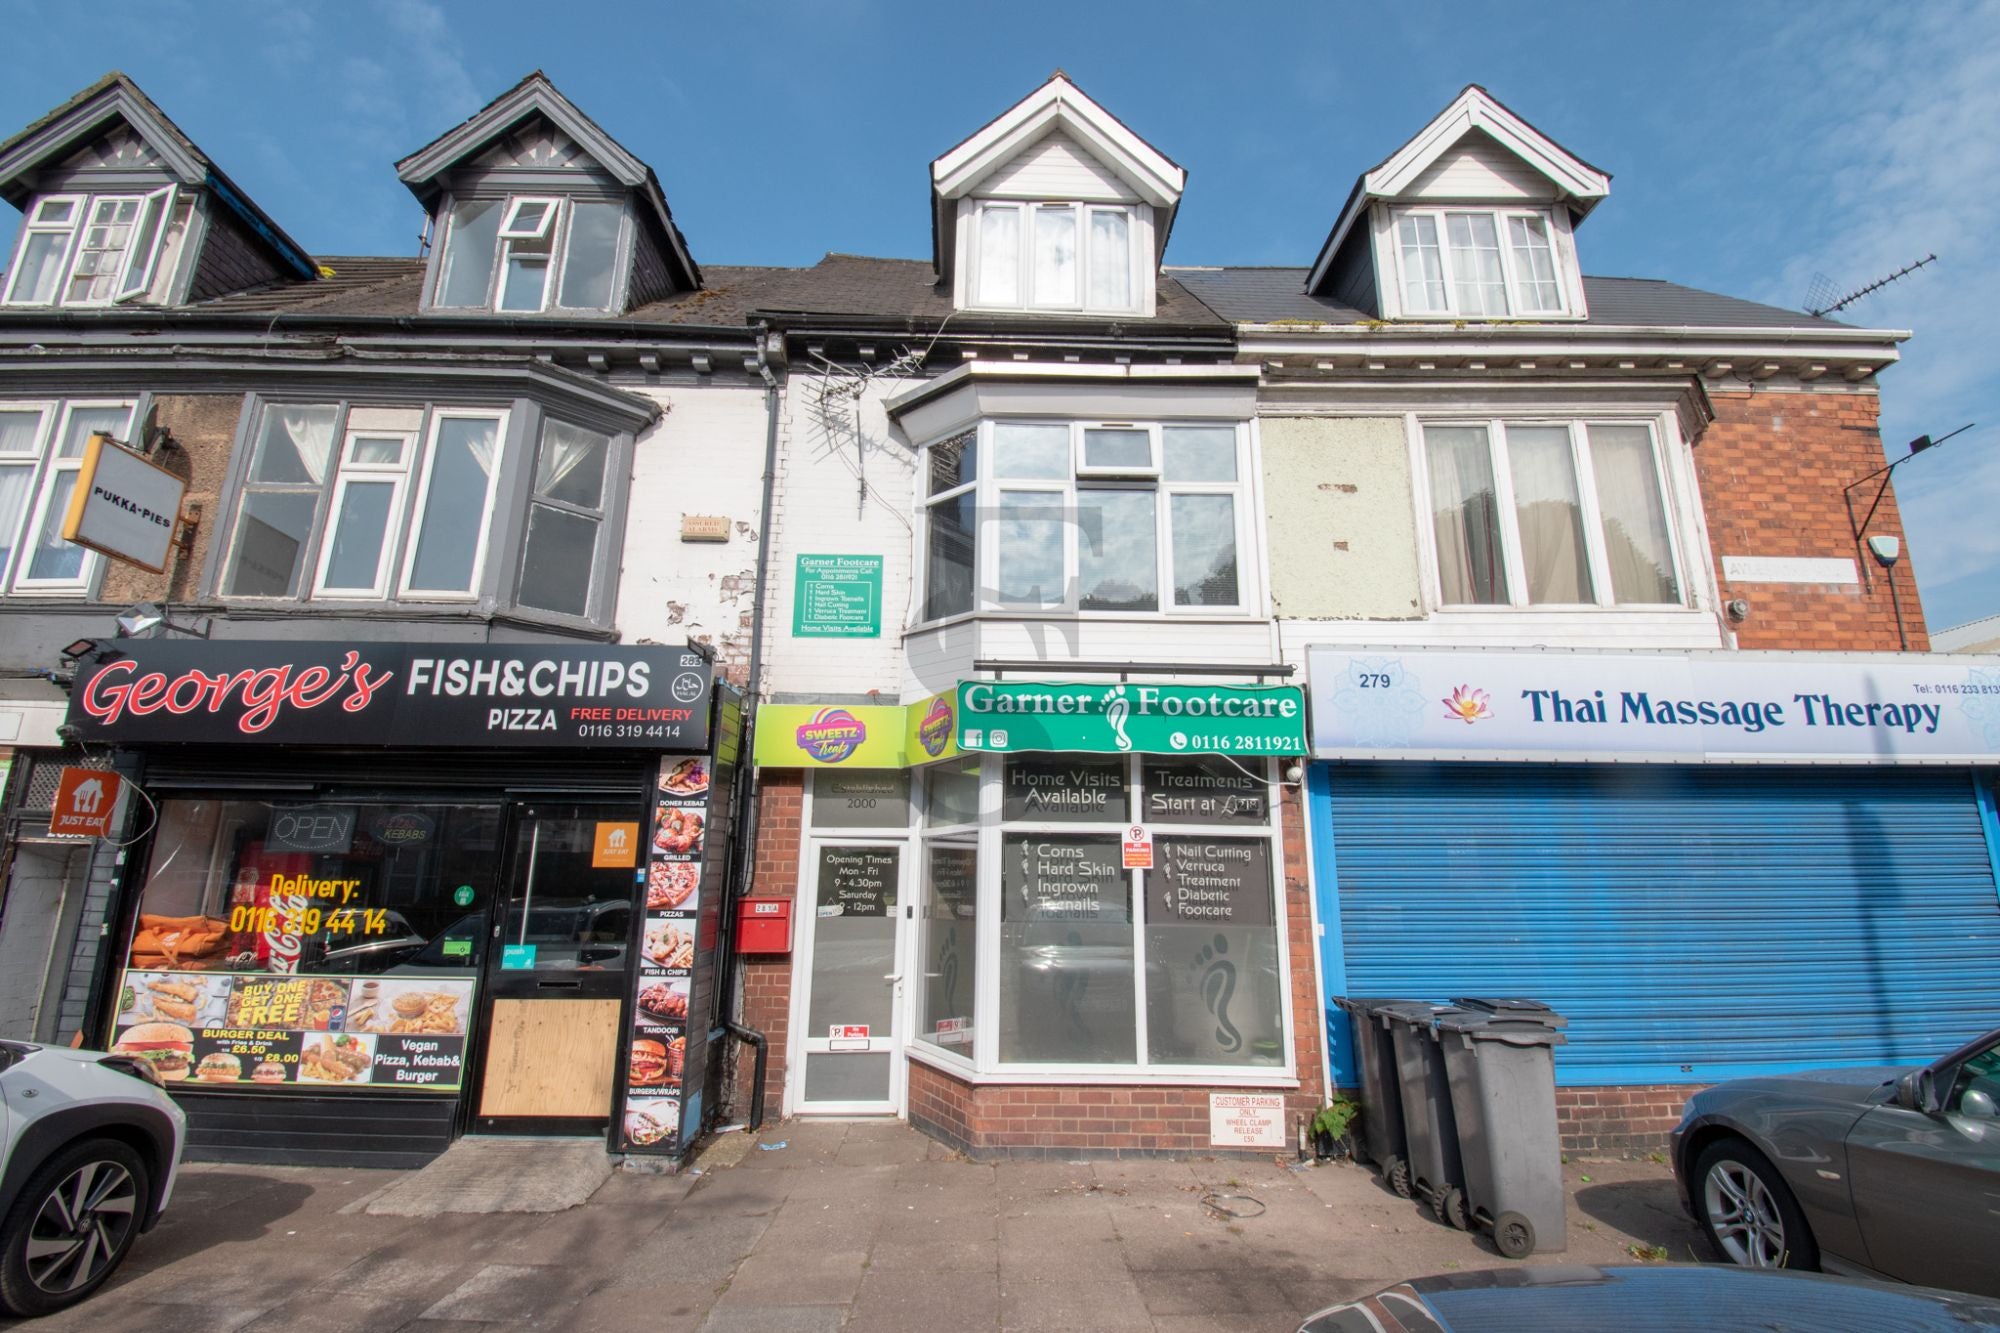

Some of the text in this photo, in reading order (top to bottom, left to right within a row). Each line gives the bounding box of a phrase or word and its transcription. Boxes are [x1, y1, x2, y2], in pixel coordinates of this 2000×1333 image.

[94, 487, 170, 528] PUKKA-PIES
[801, 557, 879, 566] Garner Footcare
[682, 656, 701, 665] 283
[407, 659, 650, 697] FISH&CHIPS
[1359, 674, 1391, 688] 279
[83, 650, 394, 734] George's
[1913, 684, 2000, 694] Tel: 0116 233 813
[965, 685, 1297, 718] Garner Footcare
[570, 707, 693, 721] FREE DELIVERY
[1521, 690, 1941, 733] Thai Massage Therapy
[487, 708, 558, 731] PIZZA
[579, 724, 680, 738] 0116 319 4414
[805, 727, 858, 741] SWEETZ
[1192, 735, 1301, 750] 0116 2811921
[1012, 770, 1121, 787] Home Visits
[1155, 771, 1253, 788] Treatments
[1025, 788, 1107, 804] Available
[1151, 793, 1195, 810] Start
[1200, 797, 1216, 811] at
[847, 799, 877, 809] 2000
[60, 814, 106, 826] JUST EAT
[384, 829, 427, 840] KEBABS
[1037, 844, 1085, 858] Corns
[1177, 845, 1252, 861] Nail Cutting
[826, 854, 893, 865] Opening Times
[1176, 859, 1225, 871] Verruca
[839, 867, 859, 875] Mon
[867, 867, 879, 875] Fri
[1038, 861, 1115, 875] Hard Skin
[1177, 873, 1241, 886] Treatment
[269, 873, 361, 904] Delivery:
[1038, 878, 1098, 896] Ingrown
[1178, 888, 1230, 900] Diabetic
[839, 890, 877, 901] Saturday
[853, 902, 875, 912] 12pm
[1037, 896, 1100, 911] Toenails
[1178, 902, 1232, 915] Footcare
[231, 905, 388, 935] 0116 319 44 14
[659, 910, 684, 918] PIZZAS
[504, 947, 525, 957] push
[644, 968, 660, 976] FISH
[667, 968, 688, 976] CHIPS
[243, 980, 306, 996] BUY ONE
[241, 992, 303, 1008] GET ONE
[236, 1002, 300, 1027] FREE
[202, 1029, 290, 1041] BURGER DEAL
[231, 1045, 266, 1054] £6.50
[401, 1039, 438, 1053] Vegan
[265, 1053, 299, 1063] £8.00
[374, 1055, 461, 1067] Pizza, Kebab&
[396, 1070, 438, 1083] Burger
[1215, 1096, 1280, 1107] CUSTOMER PARKING
[1239, 1108, 1257, 1116] ONLY
[1249, 1119, 1272, 1127] CLAMP
